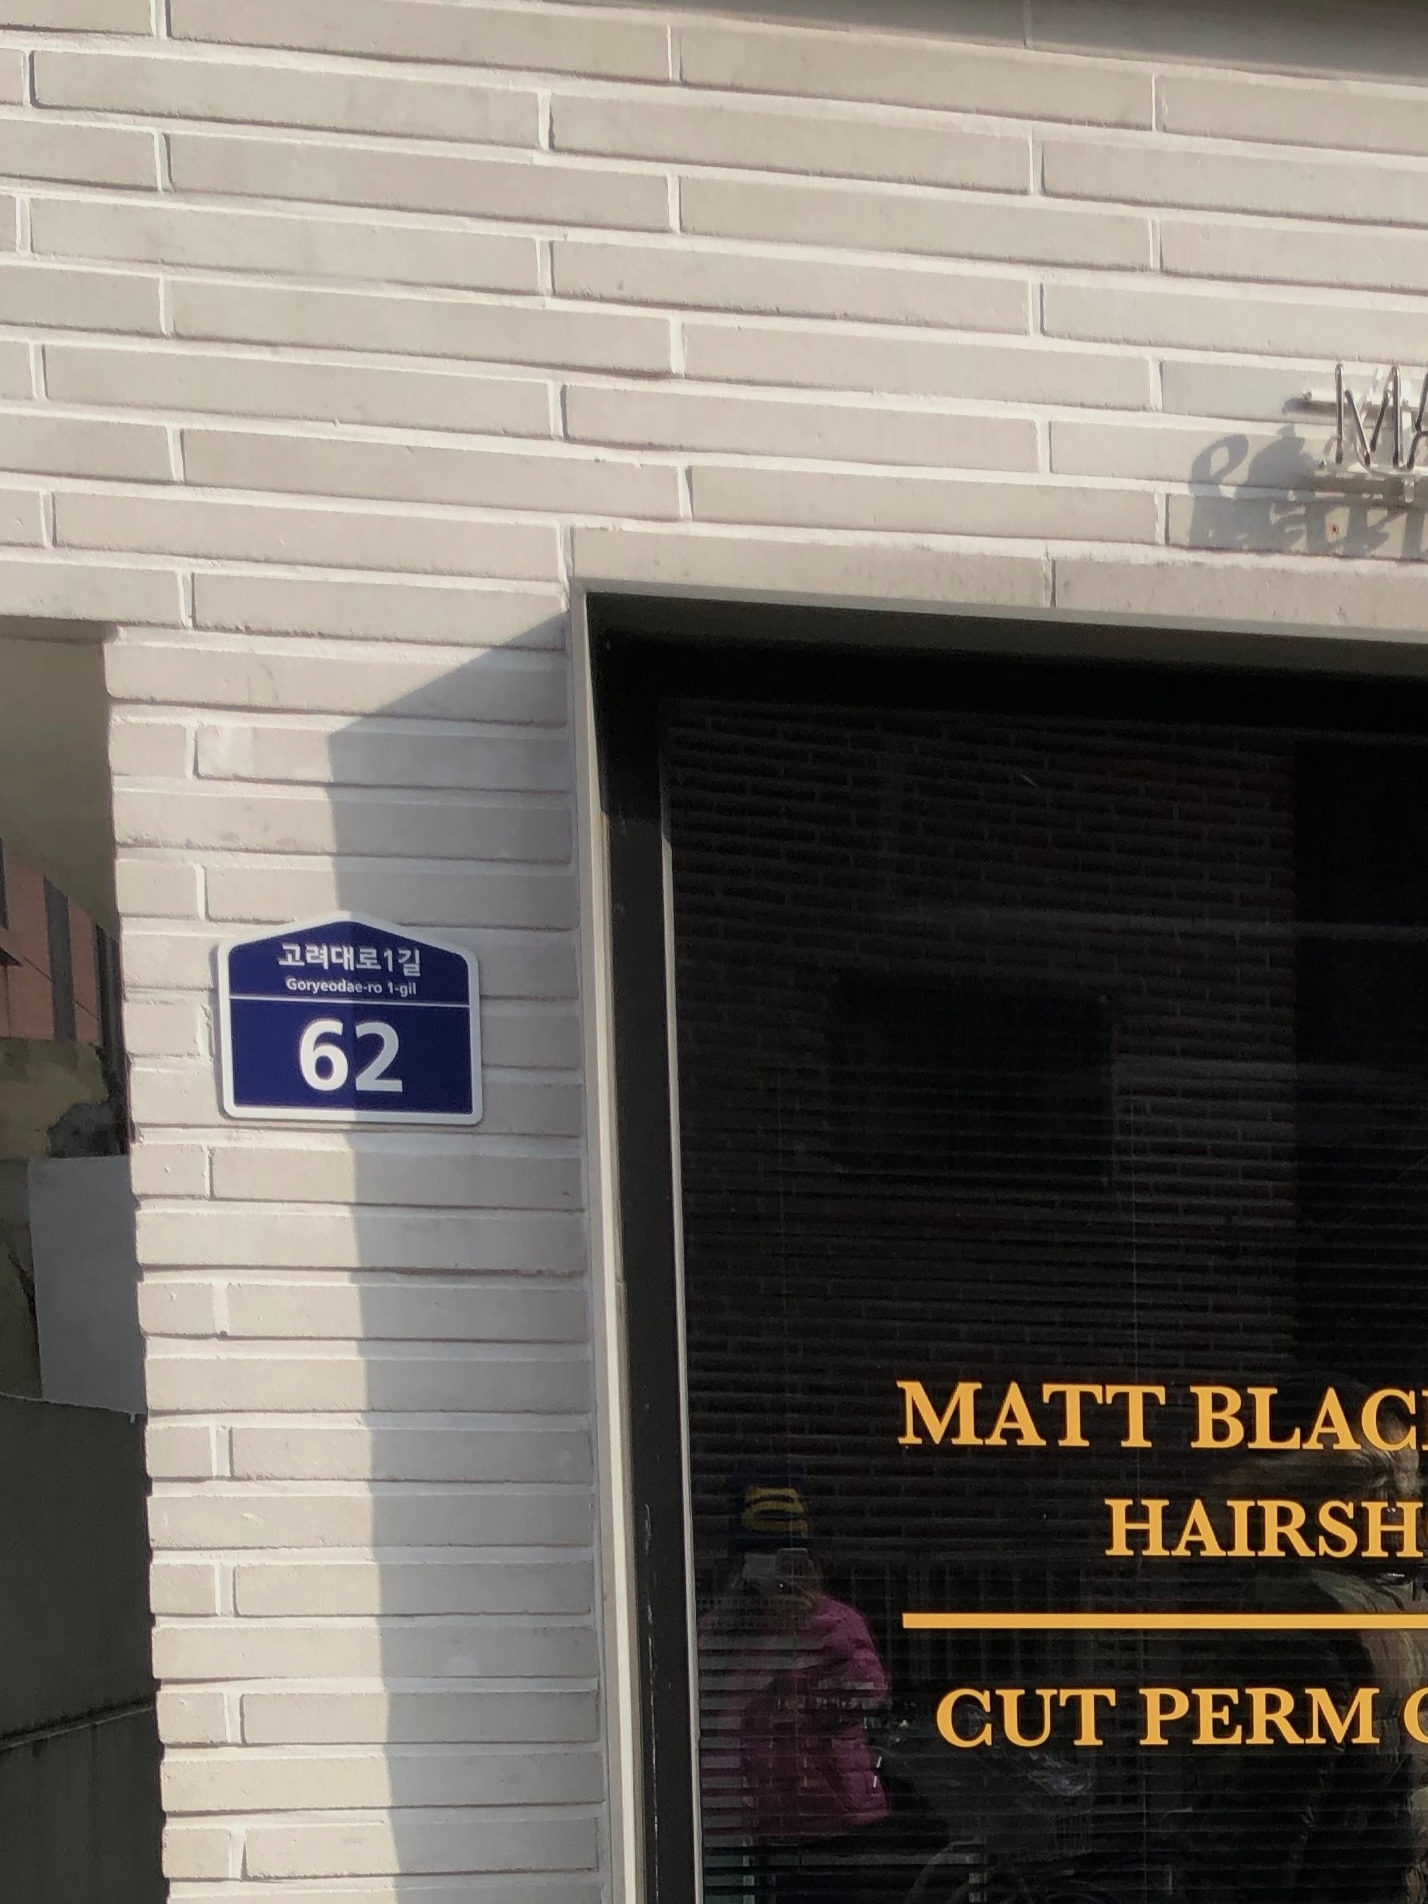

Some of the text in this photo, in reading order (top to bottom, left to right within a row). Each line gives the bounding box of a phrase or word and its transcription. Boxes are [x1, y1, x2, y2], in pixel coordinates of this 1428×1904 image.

[278, 942, 421, 977] 고려대로1길
[286, 978, 417, 997] Goryeodae-ro 1-gil
[299, 1019, 403, 1093] 62
[896, 1380, 1166, 1448] MATT
[936, 1688, 1116, 1748] CUT
[1139, 1687, 1380, 1745] PERM
